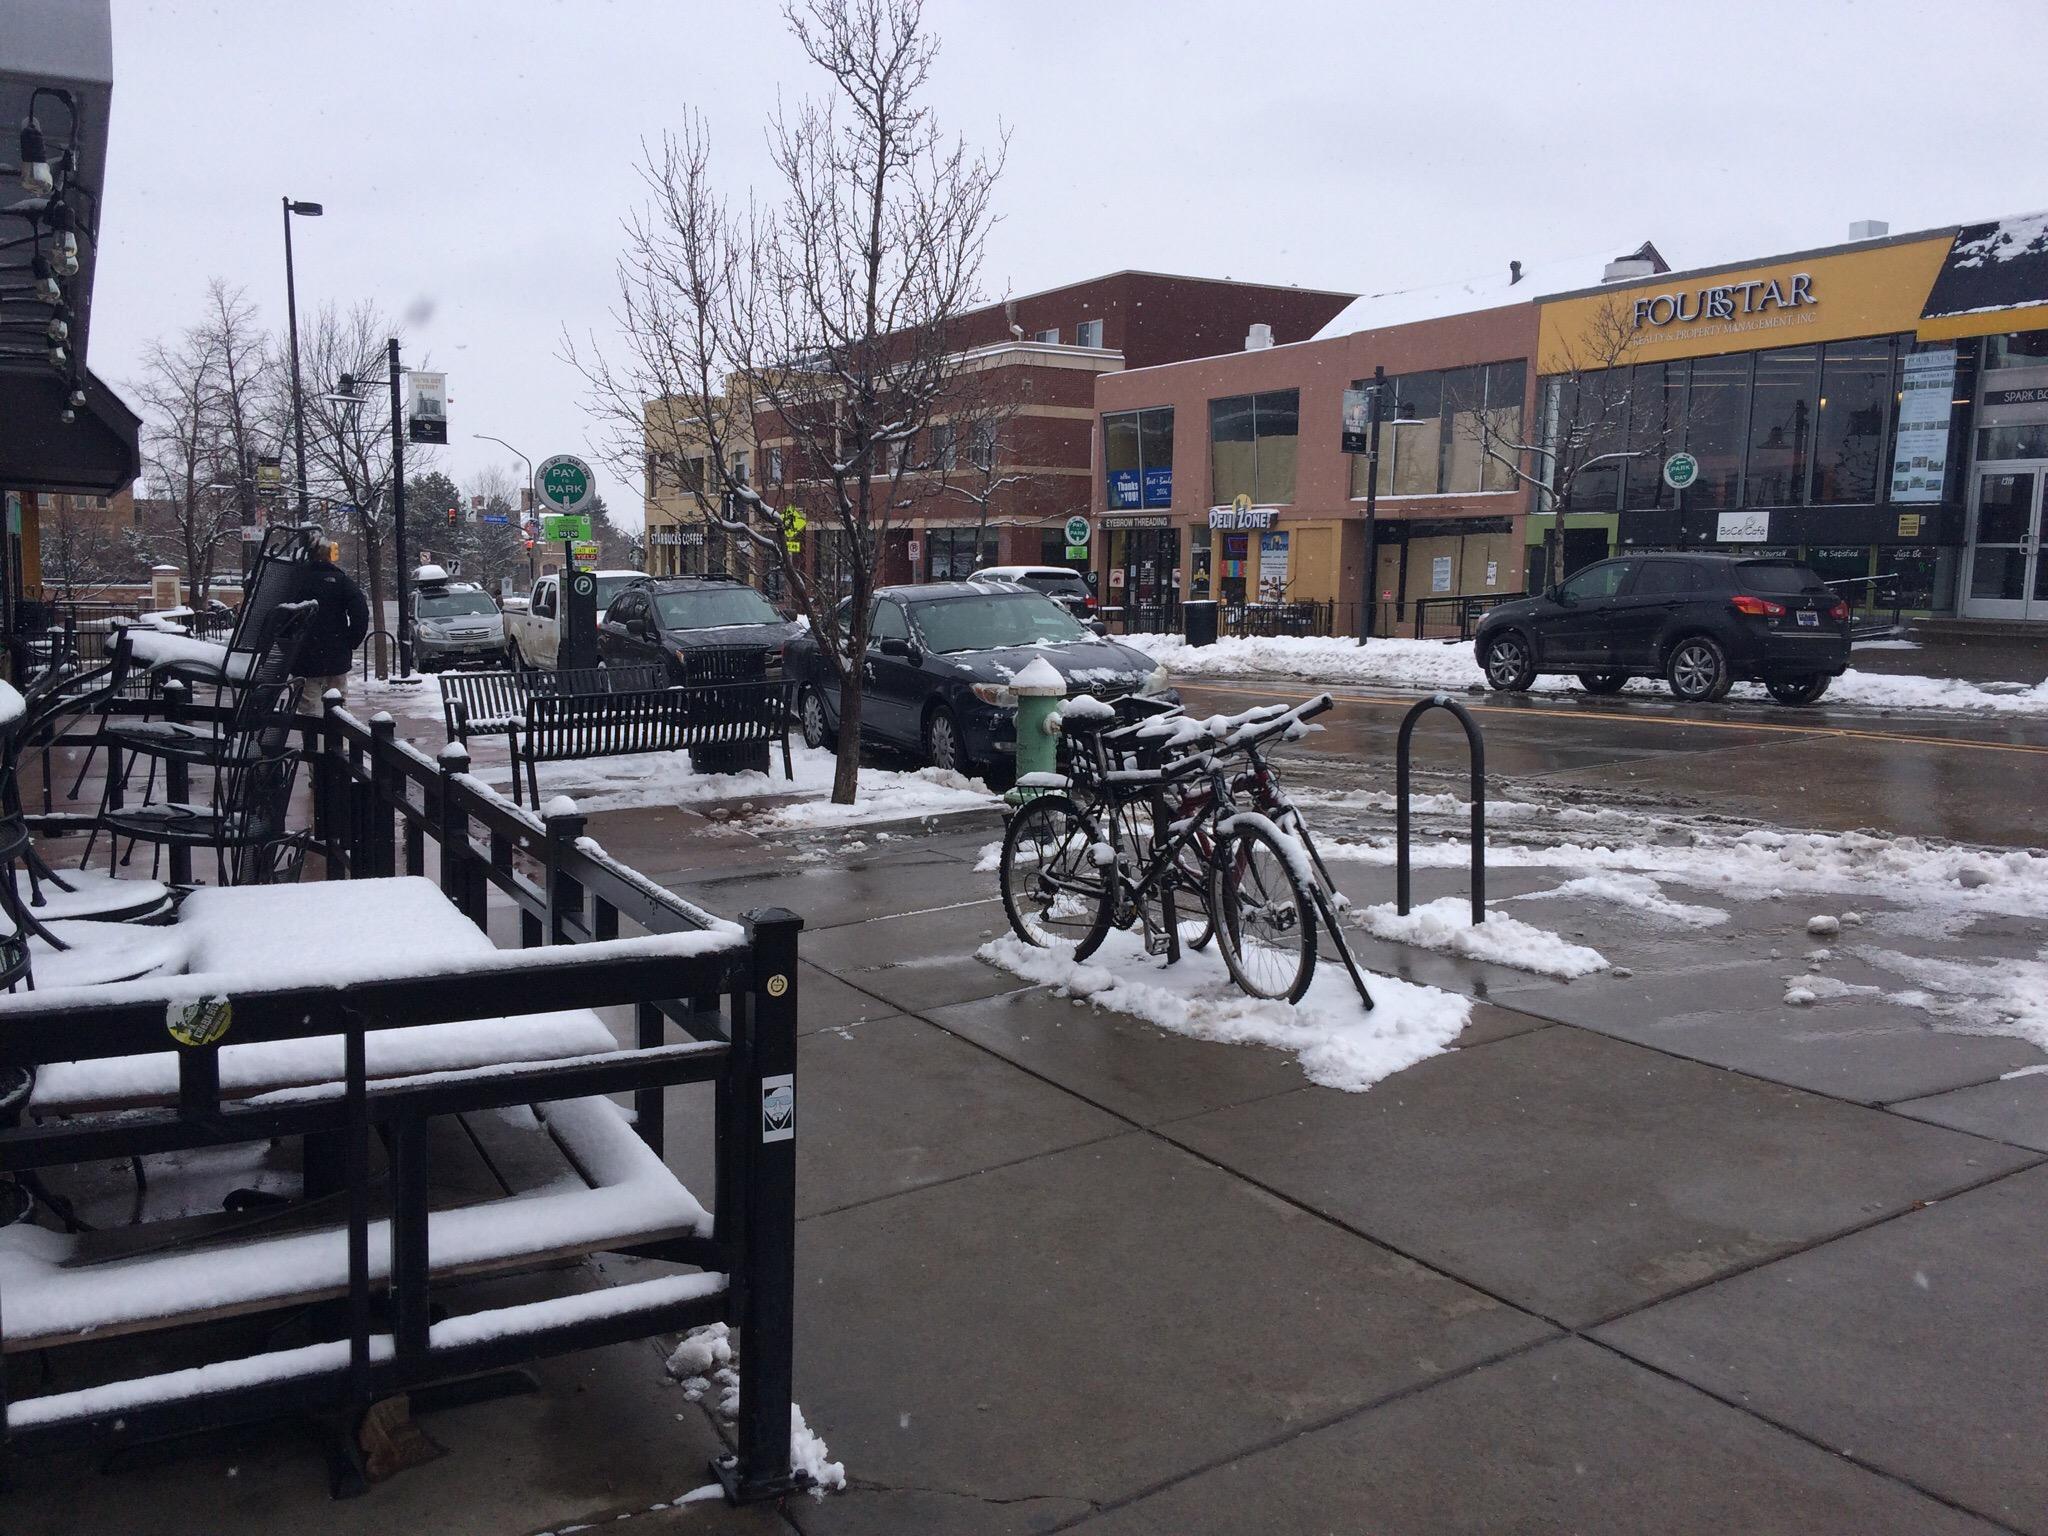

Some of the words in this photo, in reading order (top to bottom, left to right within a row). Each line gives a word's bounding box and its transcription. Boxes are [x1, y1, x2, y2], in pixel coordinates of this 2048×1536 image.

[1676, 325, 1721, 340] PROPERTY
[2003, 390, 2034, 402] SPARK
[552, 468, 577, 478] PAY
[1670, 464, 1690, 472] PARK
[548, 484, 583, 493] PARK
[1117, 481, 1139, 492] Thanks
[1124, 491, 1139, 502] YOU!
[1106, 518, 1133, 527] EYEBROW
[1134, 517, 1168, 527] THREADING
[1209, 509, 1232, 529] DELI
[651, 532, 682, 545] STARBUCKS
[682, 532, 704, 545] COFFEE
[1761, 549, 1787, 558] Yourself
[1818, 549, 1828, 557] Be
[1829, 549, 1859, 557] Satisfied
[1893, 549, 1910, 559] Just
[1912, 548, 1922, 558] Be
